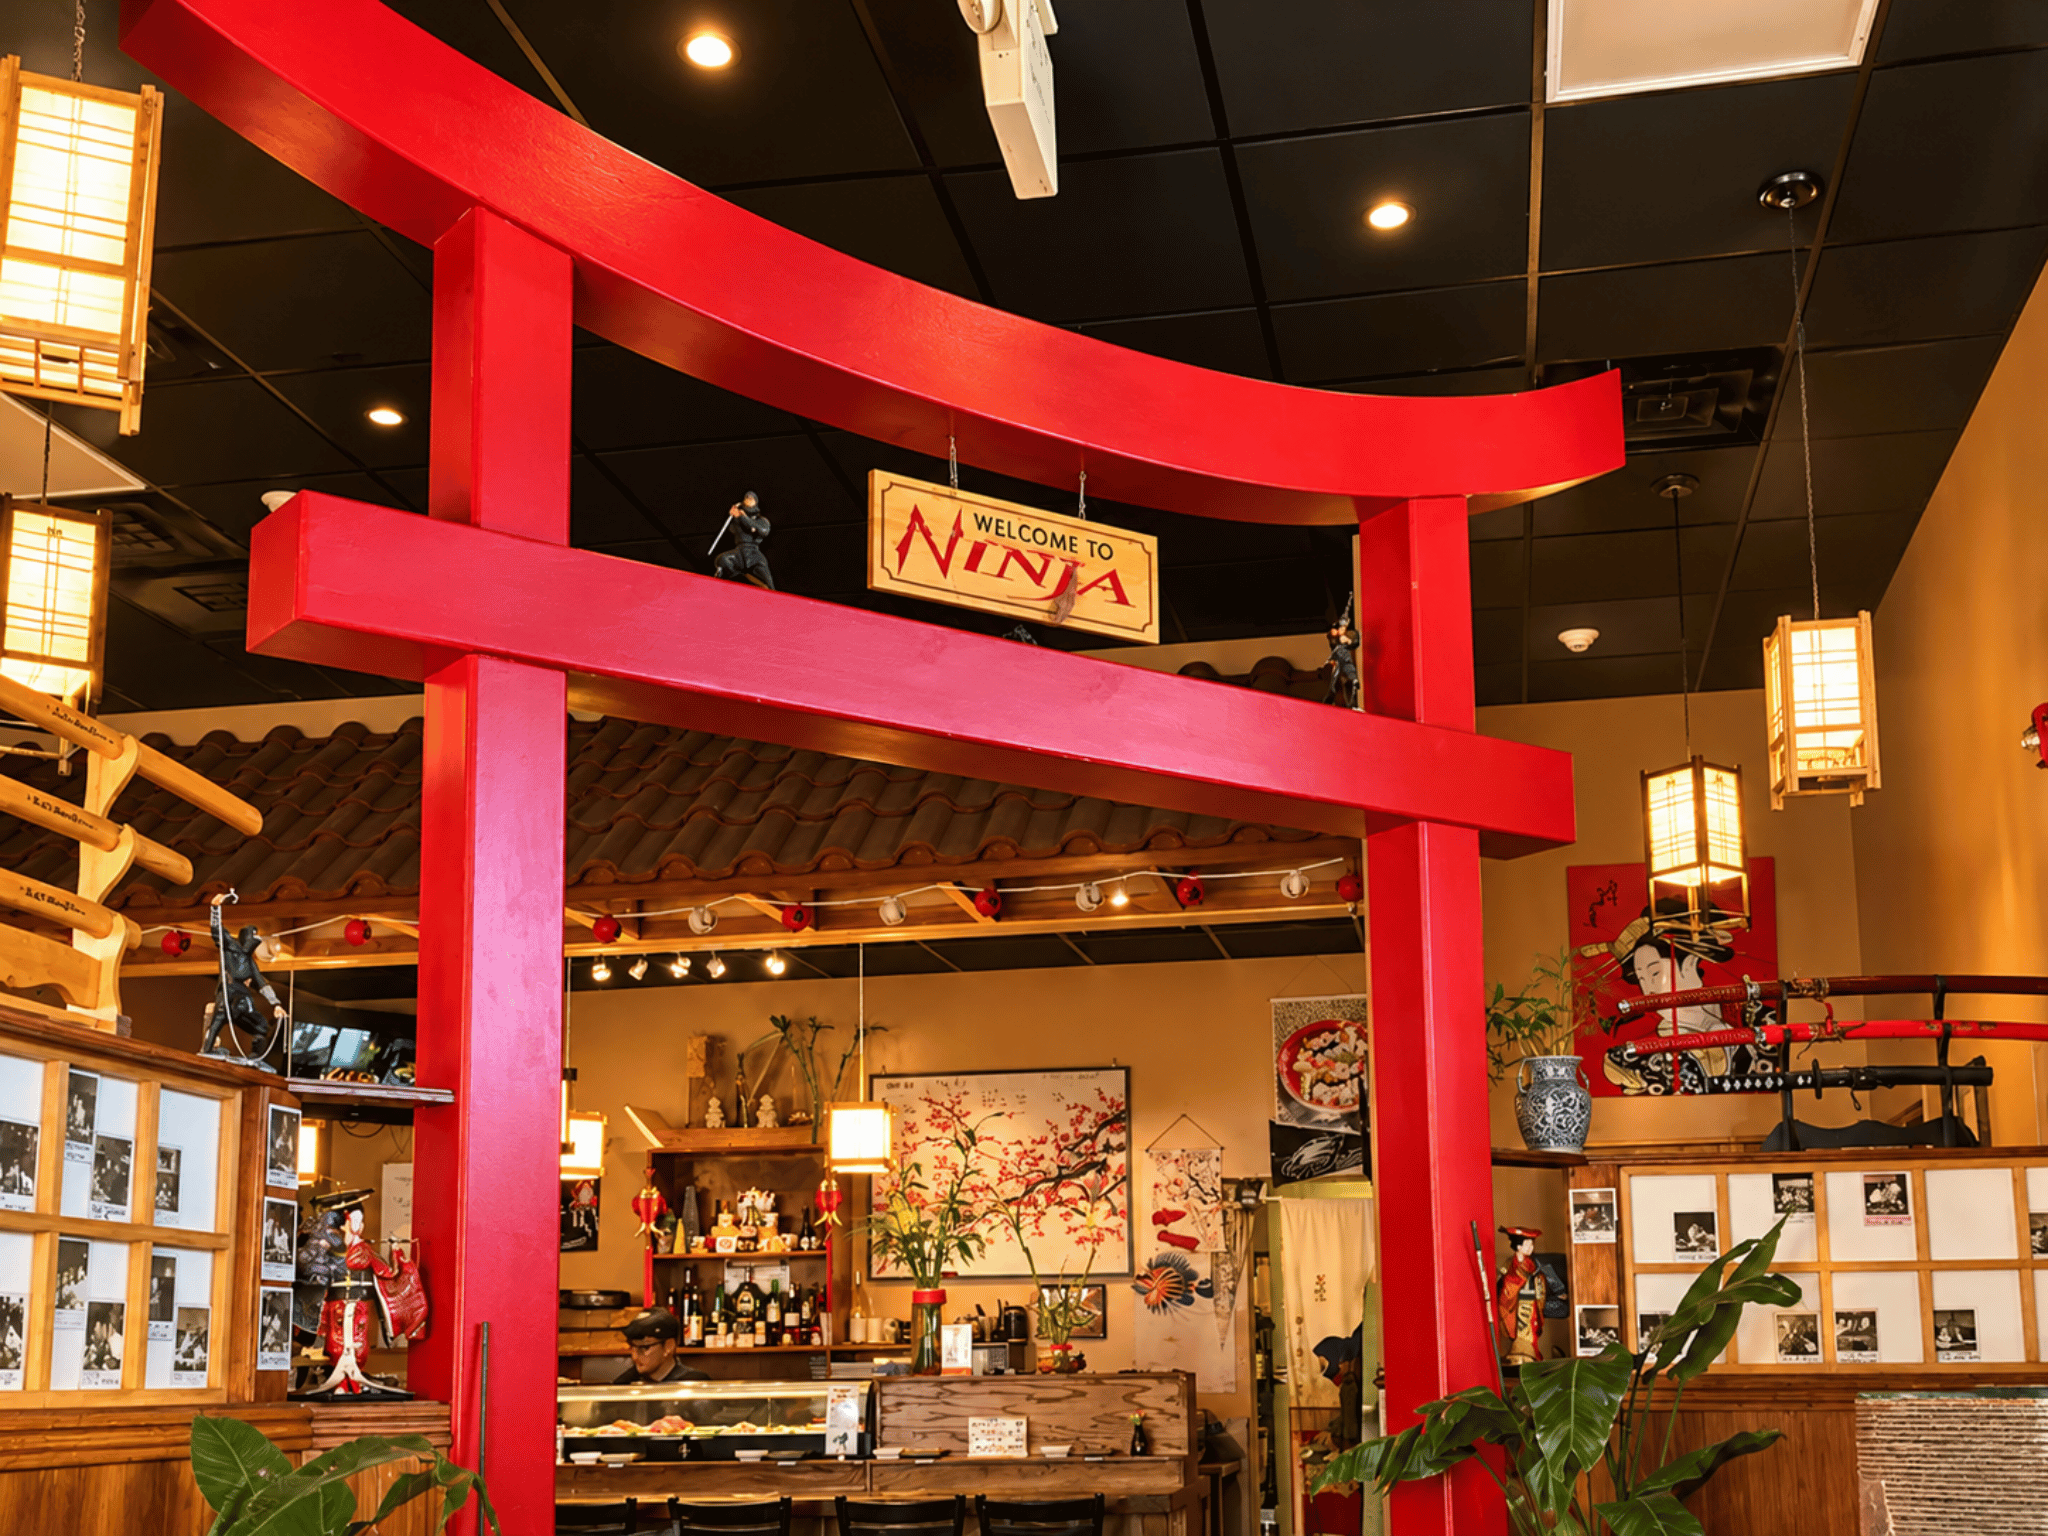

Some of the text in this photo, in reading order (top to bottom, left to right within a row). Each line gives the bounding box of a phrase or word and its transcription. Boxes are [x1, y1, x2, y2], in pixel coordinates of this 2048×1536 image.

[895, 503, 1136, 609] NINJA
[974, 512, 1114, 561] WELCOME TO
